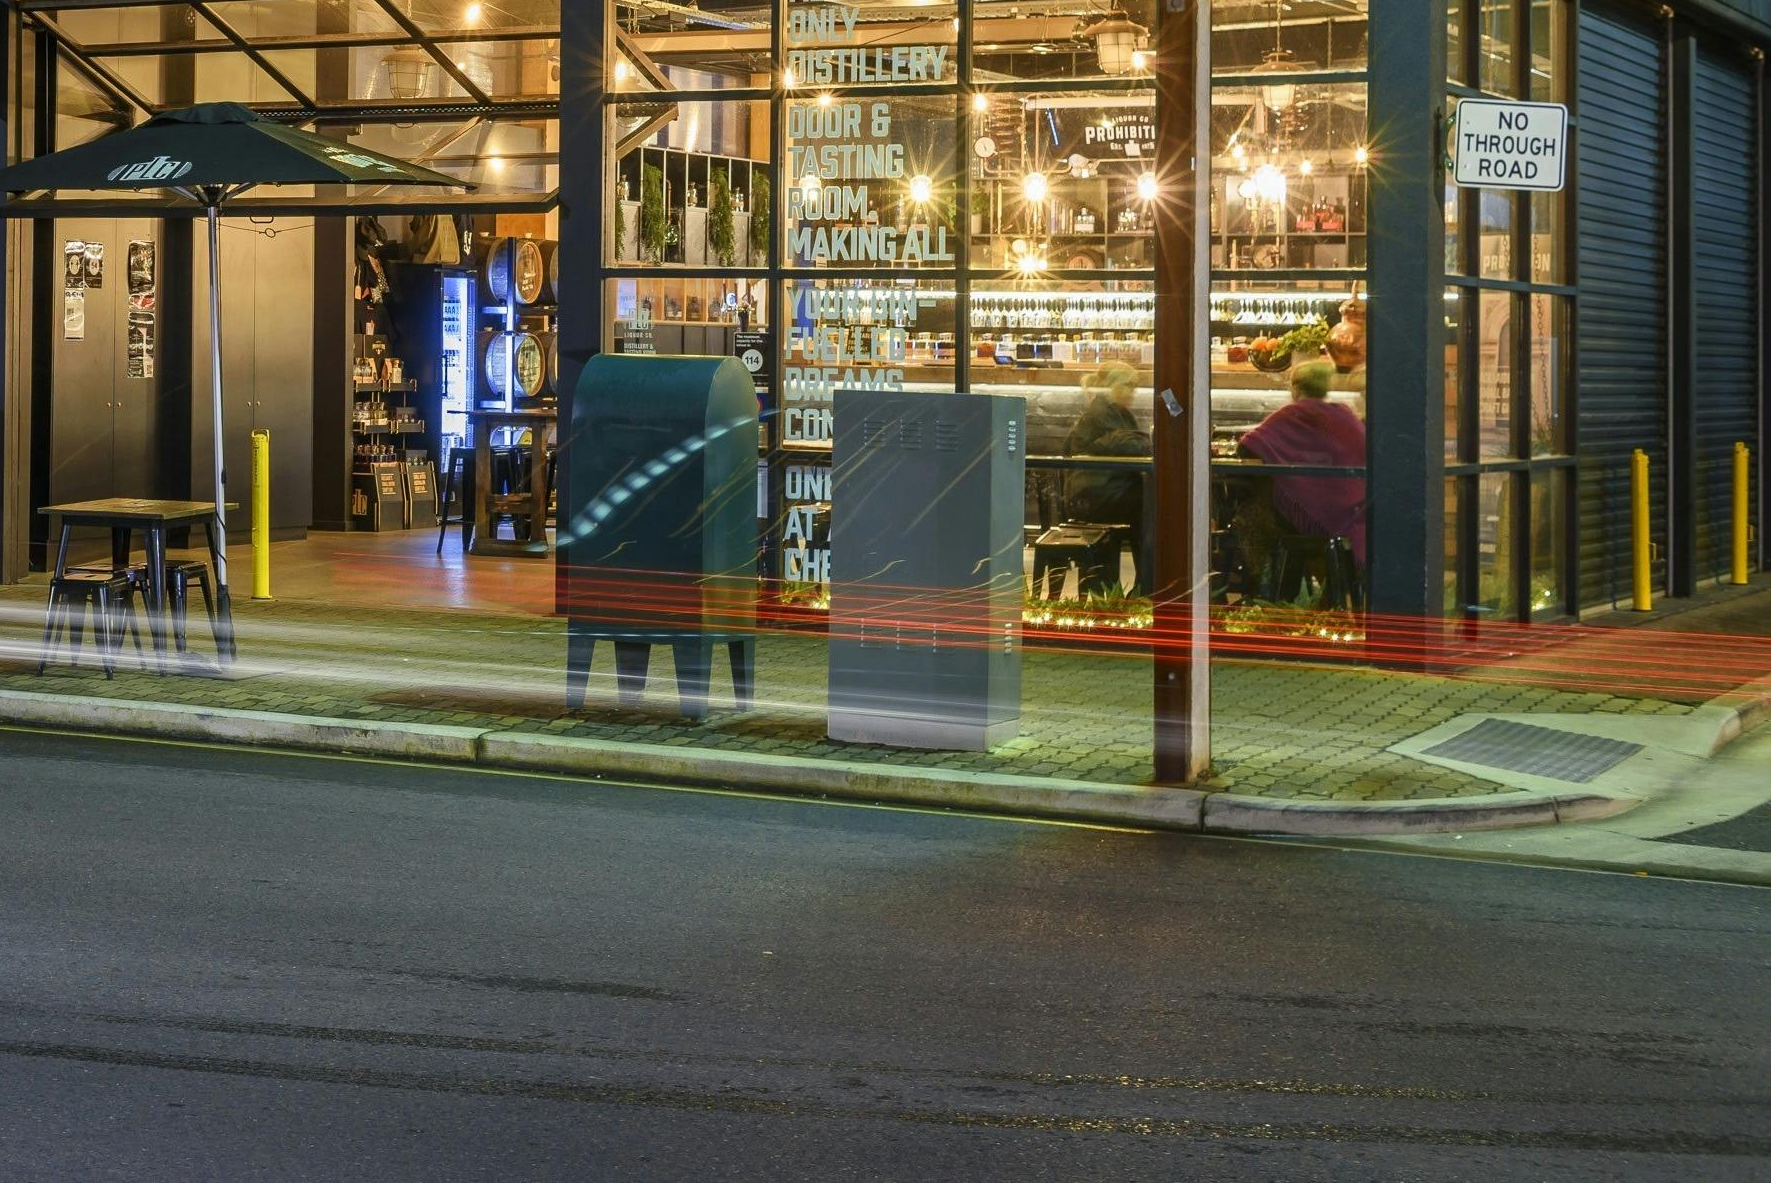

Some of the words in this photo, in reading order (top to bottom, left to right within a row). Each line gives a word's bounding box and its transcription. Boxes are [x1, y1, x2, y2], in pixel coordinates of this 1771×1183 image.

[789, 6, 859, 43] ONLY
[788, 45, 949, 84] DISTILLERY
[788, 103, 862, 139] DOOR
[871, 103, 891, 138] &
[1085, 125, 1156, 144] PROHIBITI
[1499, 111, 1529, 130] NO
[788, 143, 904, 179] TASTING
[1464, 133, 1556, 156] THROUGH
[1479, 158, 1538, 179] ROAD
[788, 185, 878, 220] ROOM.
[788, 226, 897, 261] MAKING
[901, 225, 956, 261] ALL
[786, 287, 859, 321] YOUR
[871, 288, 937, 321] GIN-
[745, 356, 759, 365] 114
[786, 326, 906, 361] FUELLED
[785, 366, 904, 402] DREAMS
[784, 506, 818, 541] AT
